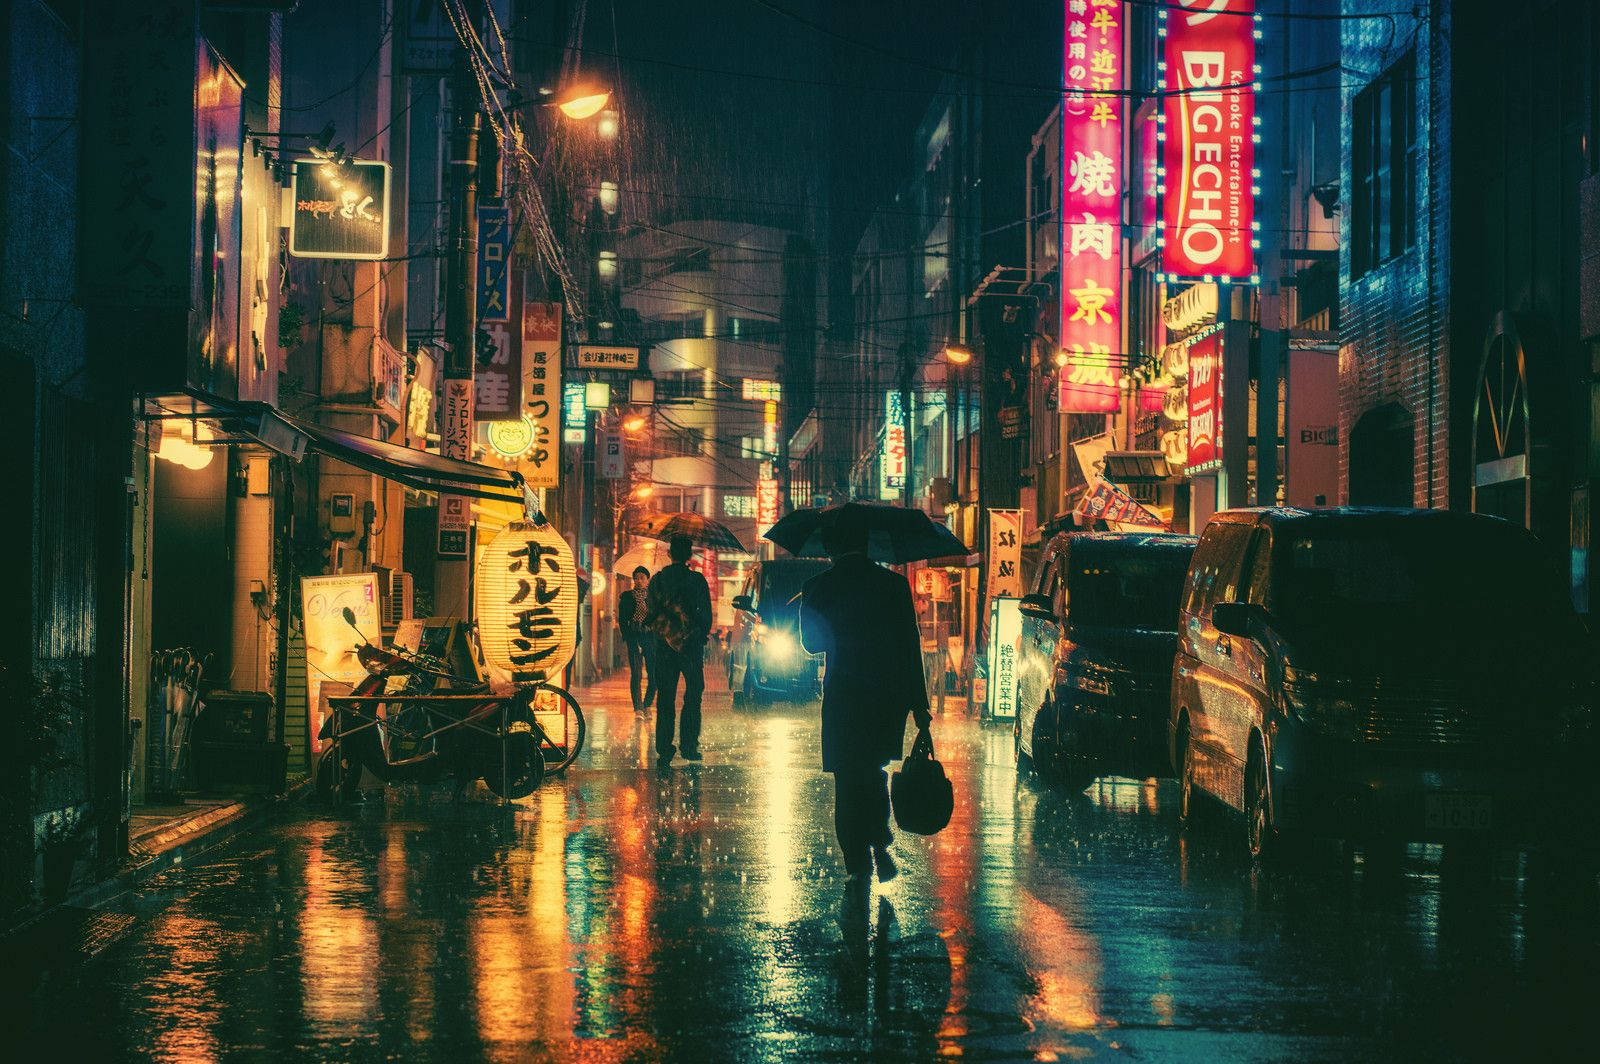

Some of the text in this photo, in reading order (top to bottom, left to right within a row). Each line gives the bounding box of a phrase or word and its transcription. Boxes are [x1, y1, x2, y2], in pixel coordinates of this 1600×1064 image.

[1090, 0, 1118, 129] 牛・近江牛
[1181, 50, 1226, 138] BIG
[1181, 146, 1226, 266] ECHO
[1229, 69, 1242, 244] Karaoke Entertainment
[482, 214, 506, 313] プロレス
[507, 540, 562, 667] ホルモン
